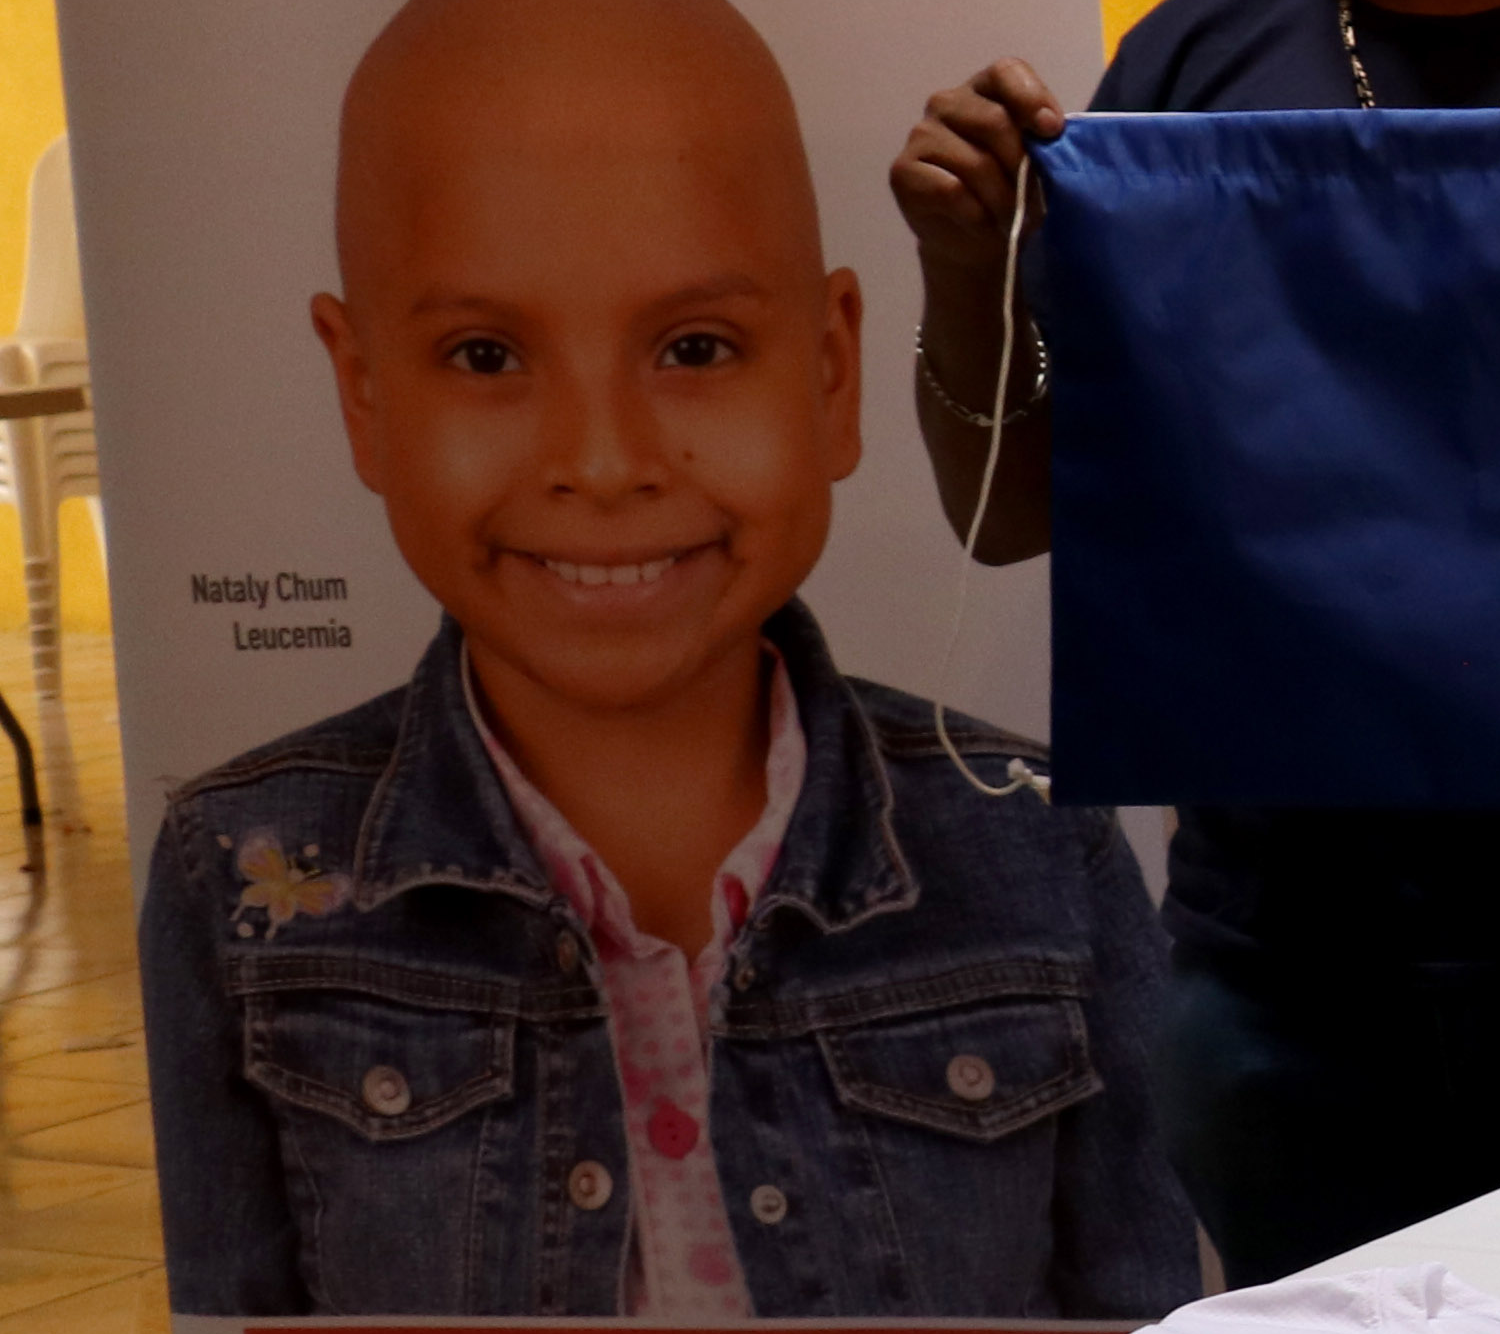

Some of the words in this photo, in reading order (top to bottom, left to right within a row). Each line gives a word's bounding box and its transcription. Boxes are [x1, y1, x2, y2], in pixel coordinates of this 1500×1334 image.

[192, 573, 268, 609] Nataly
[276, 571, 348, 601] Chum
[233, 618, 352, 651] Leucemia
